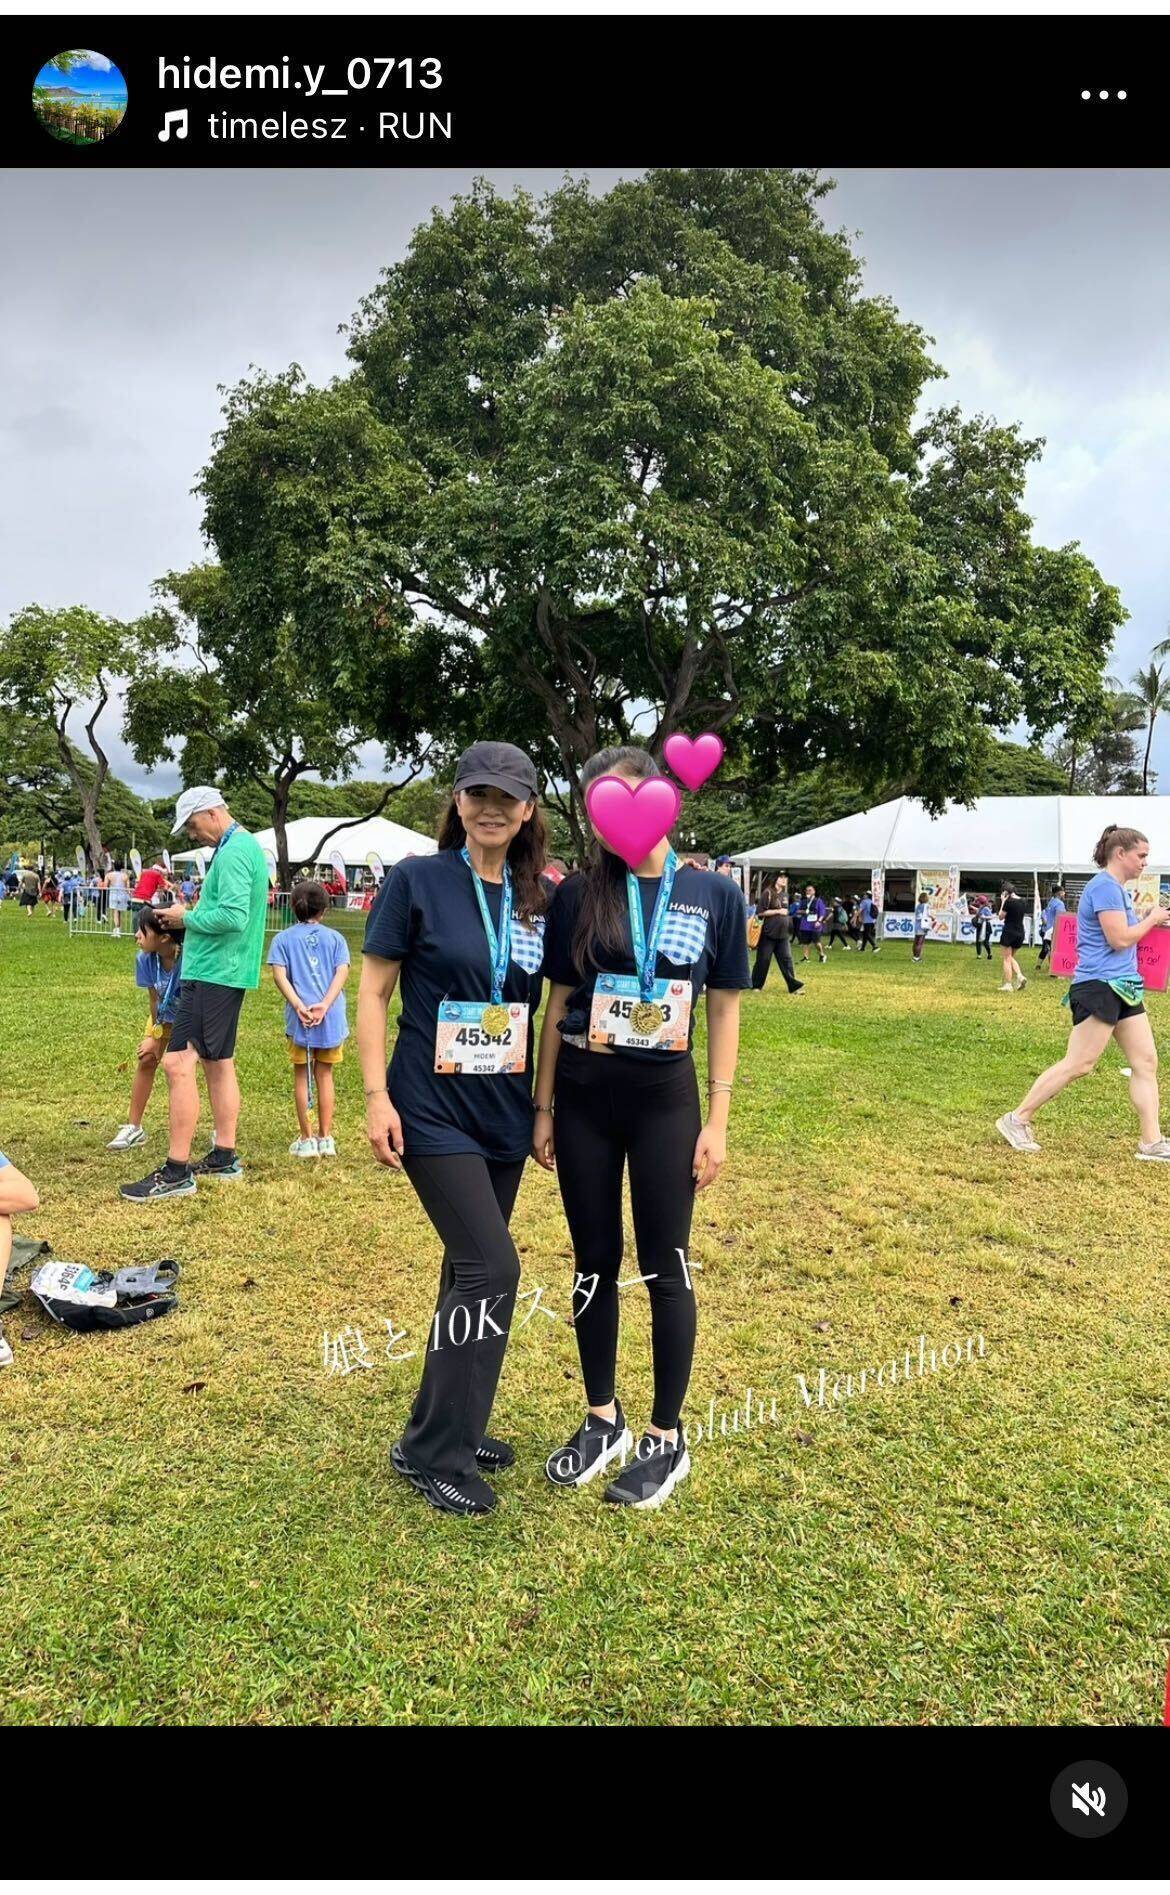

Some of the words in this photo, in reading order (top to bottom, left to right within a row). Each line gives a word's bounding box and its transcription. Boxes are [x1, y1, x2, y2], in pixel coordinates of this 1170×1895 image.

[669, 902, 710, 920] HAWAII
[885, 918, 914, 932] ぴあ
[609, 1000, 672, 1023] 453
[625, 1037, 650, 1047] 45343
[473, 1064, 496, 1072] 45342
